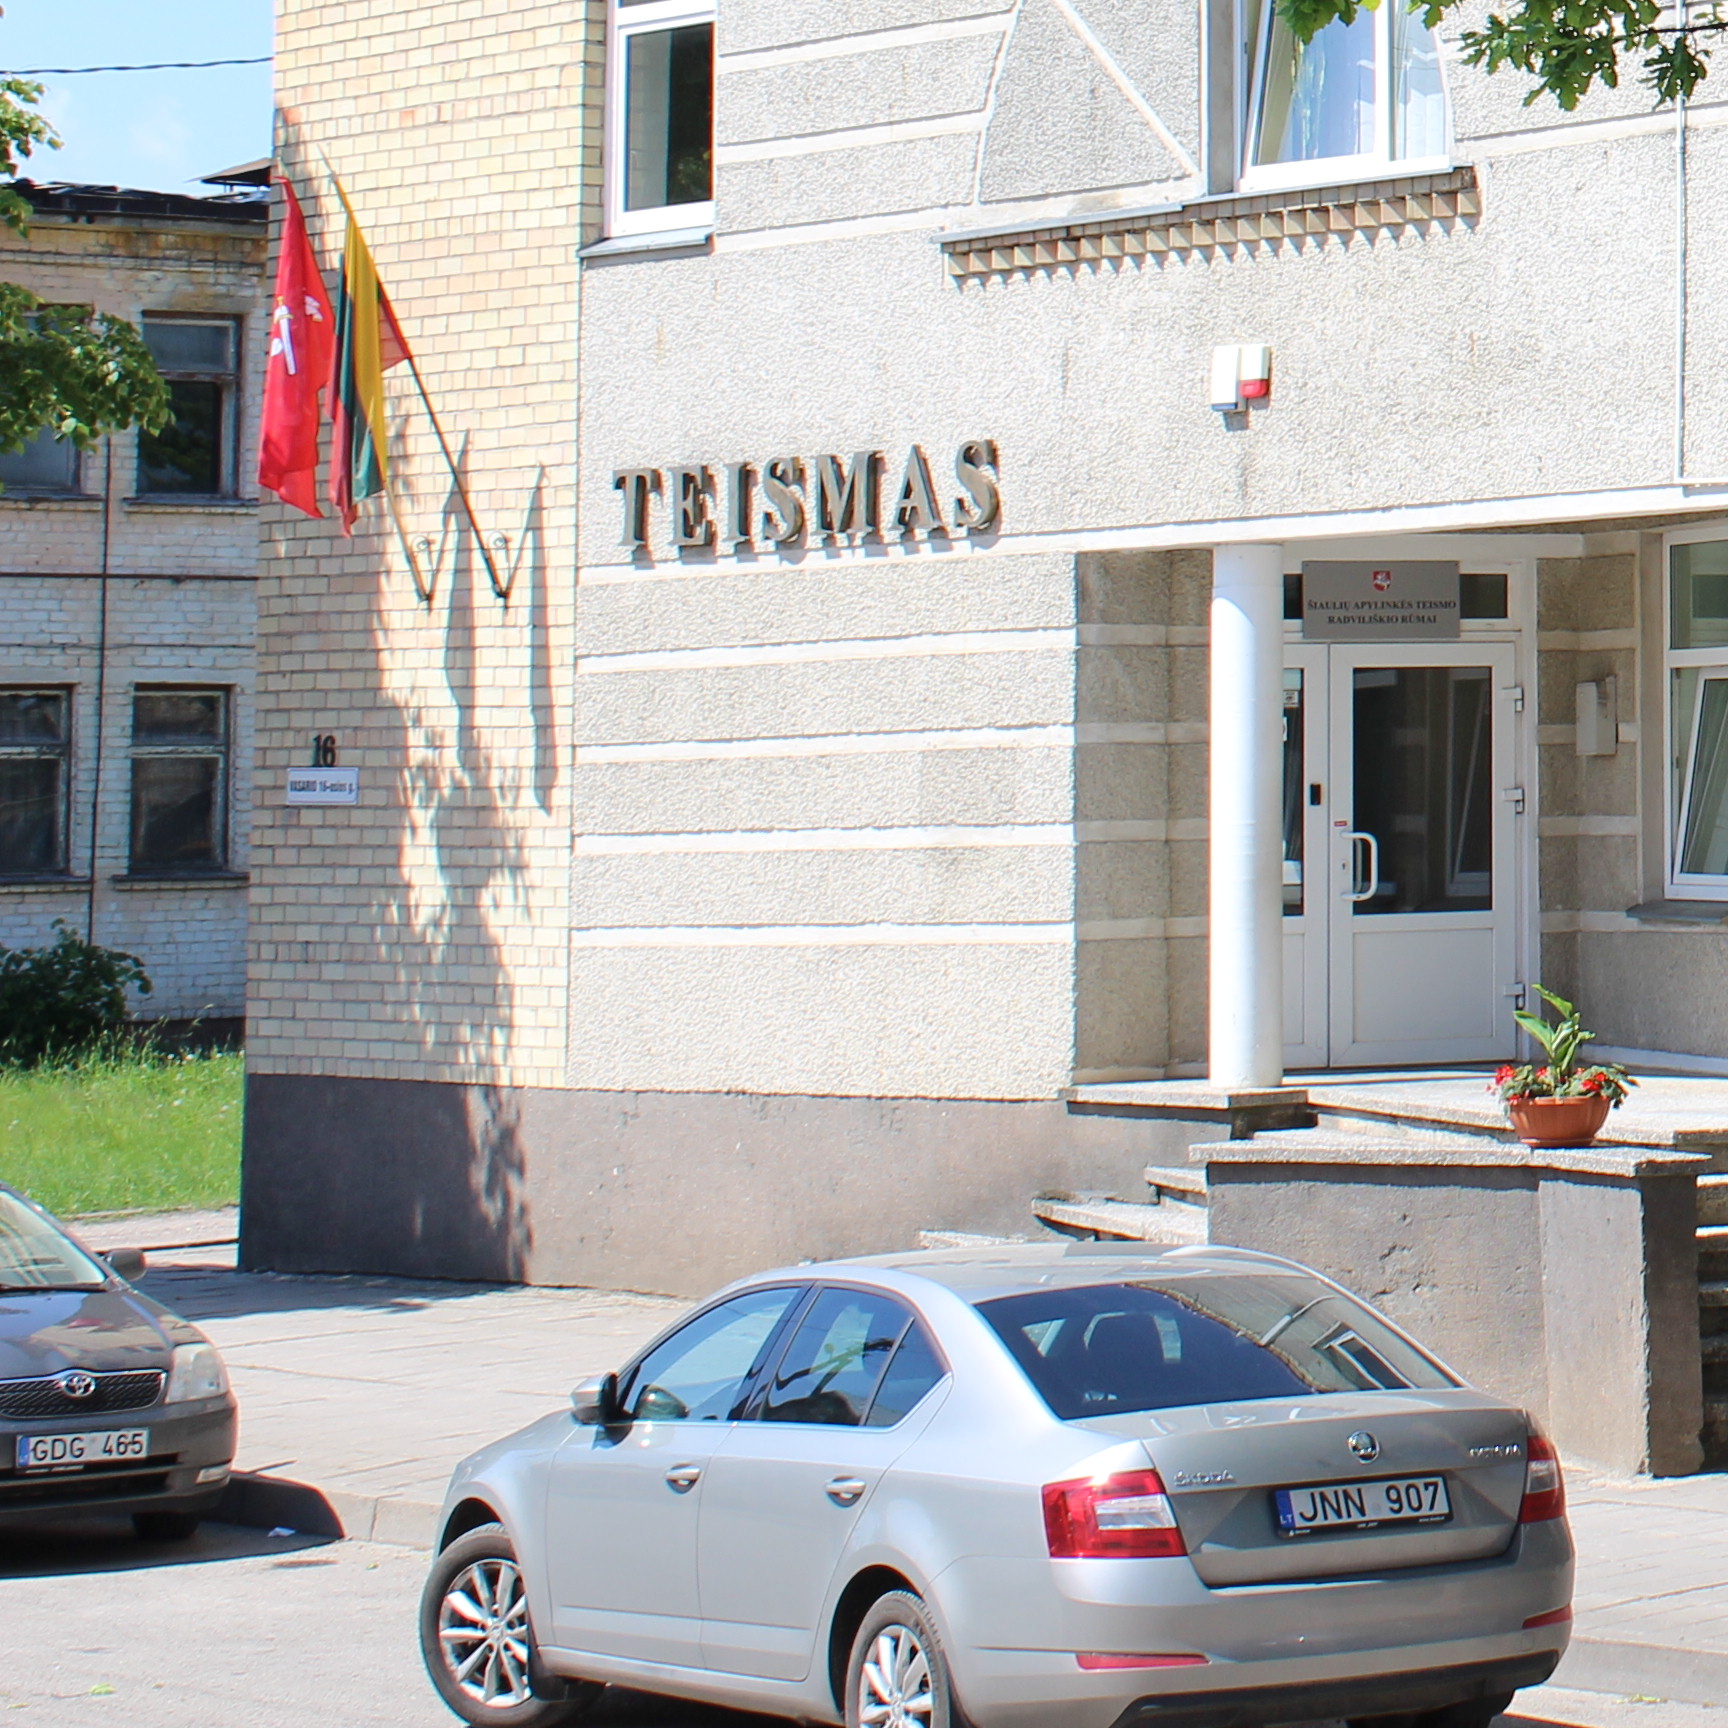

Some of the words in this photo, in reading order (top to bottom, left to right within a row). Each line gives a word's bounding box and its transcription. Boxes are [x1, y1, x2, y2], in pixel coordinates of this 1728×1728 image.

[613, 440, 999, 547] TEISMAS
[1307, 599, 1351, 612] ŠIAULIŲ
[1353, 599, 1414, 610] APYLINKĖS
[1416, 600, 1457, 610] TEISMO
[1327, 614, 1399, 625] RADVILIŠKIO
[1401, 614, 1437, 625] RŪMAI
[313, 735, 336, 767] 16
[32, 1437, 85, 1461] GDG
[102, 1432, 144, 1456] 465
[1299, 1487, 1367, 1522] JNN
[1385, 1480, 1439, 1514] 907
[1280, 1515, 1292, 1524] LT
